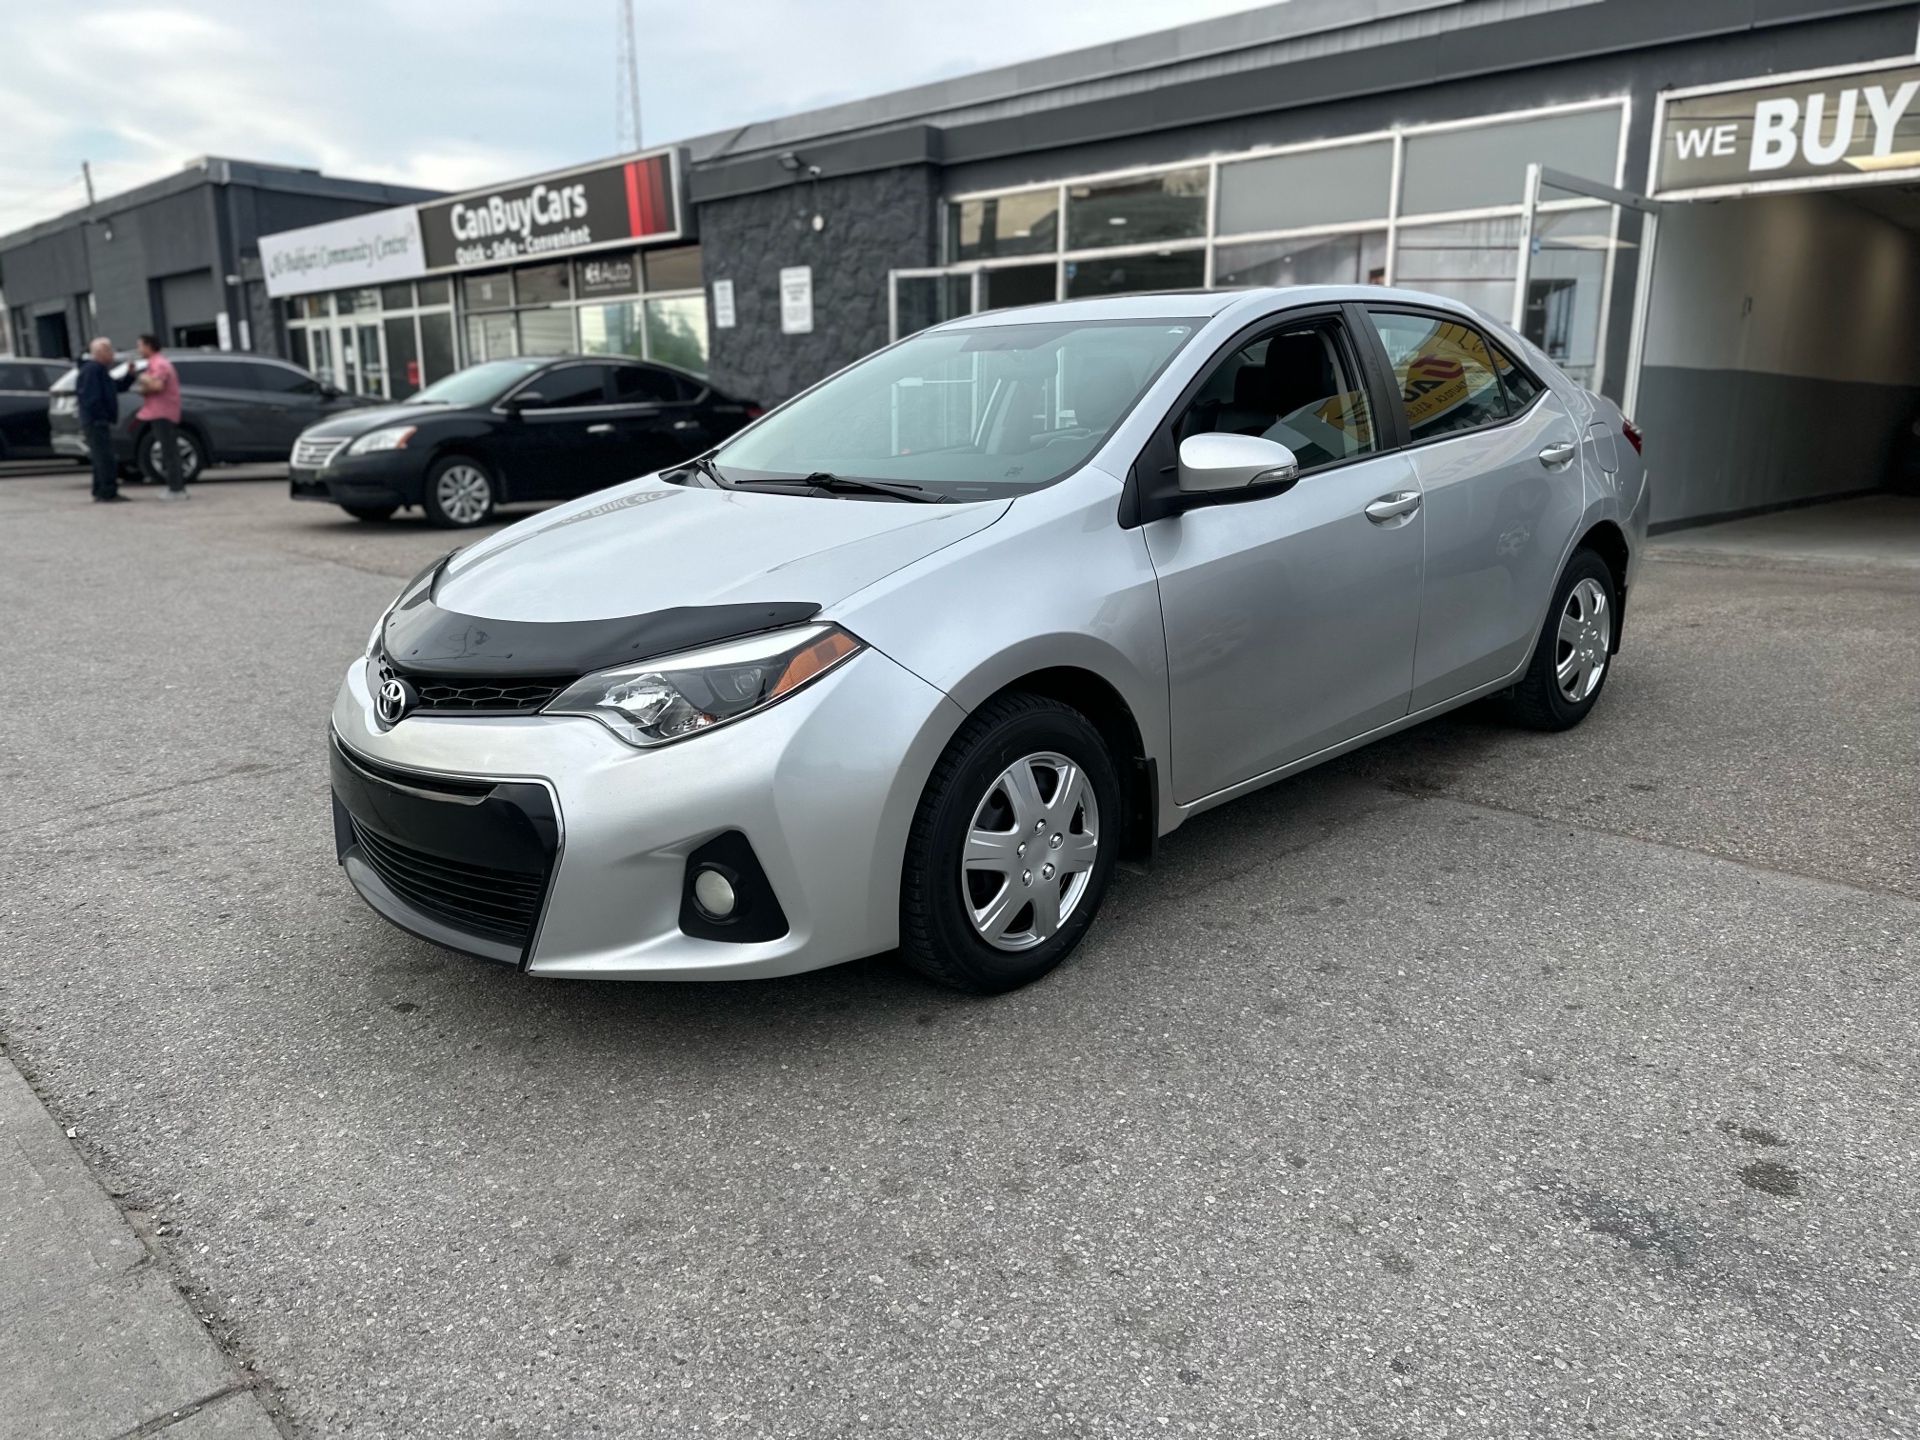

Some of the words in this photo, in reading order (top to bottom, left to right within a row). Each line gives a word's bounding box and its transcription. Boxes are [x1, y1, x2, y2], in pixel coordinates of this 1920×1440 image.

[1675, 124, 1738, 159] WE
[1748, 80, 1920, 172] BUY
[451, 184, 588, 240] CanBuyCars
[455, 243, 485, 265] Quick
[492, 238, 517, 259] Safe
[525, 225, 591, 253] Convenient
